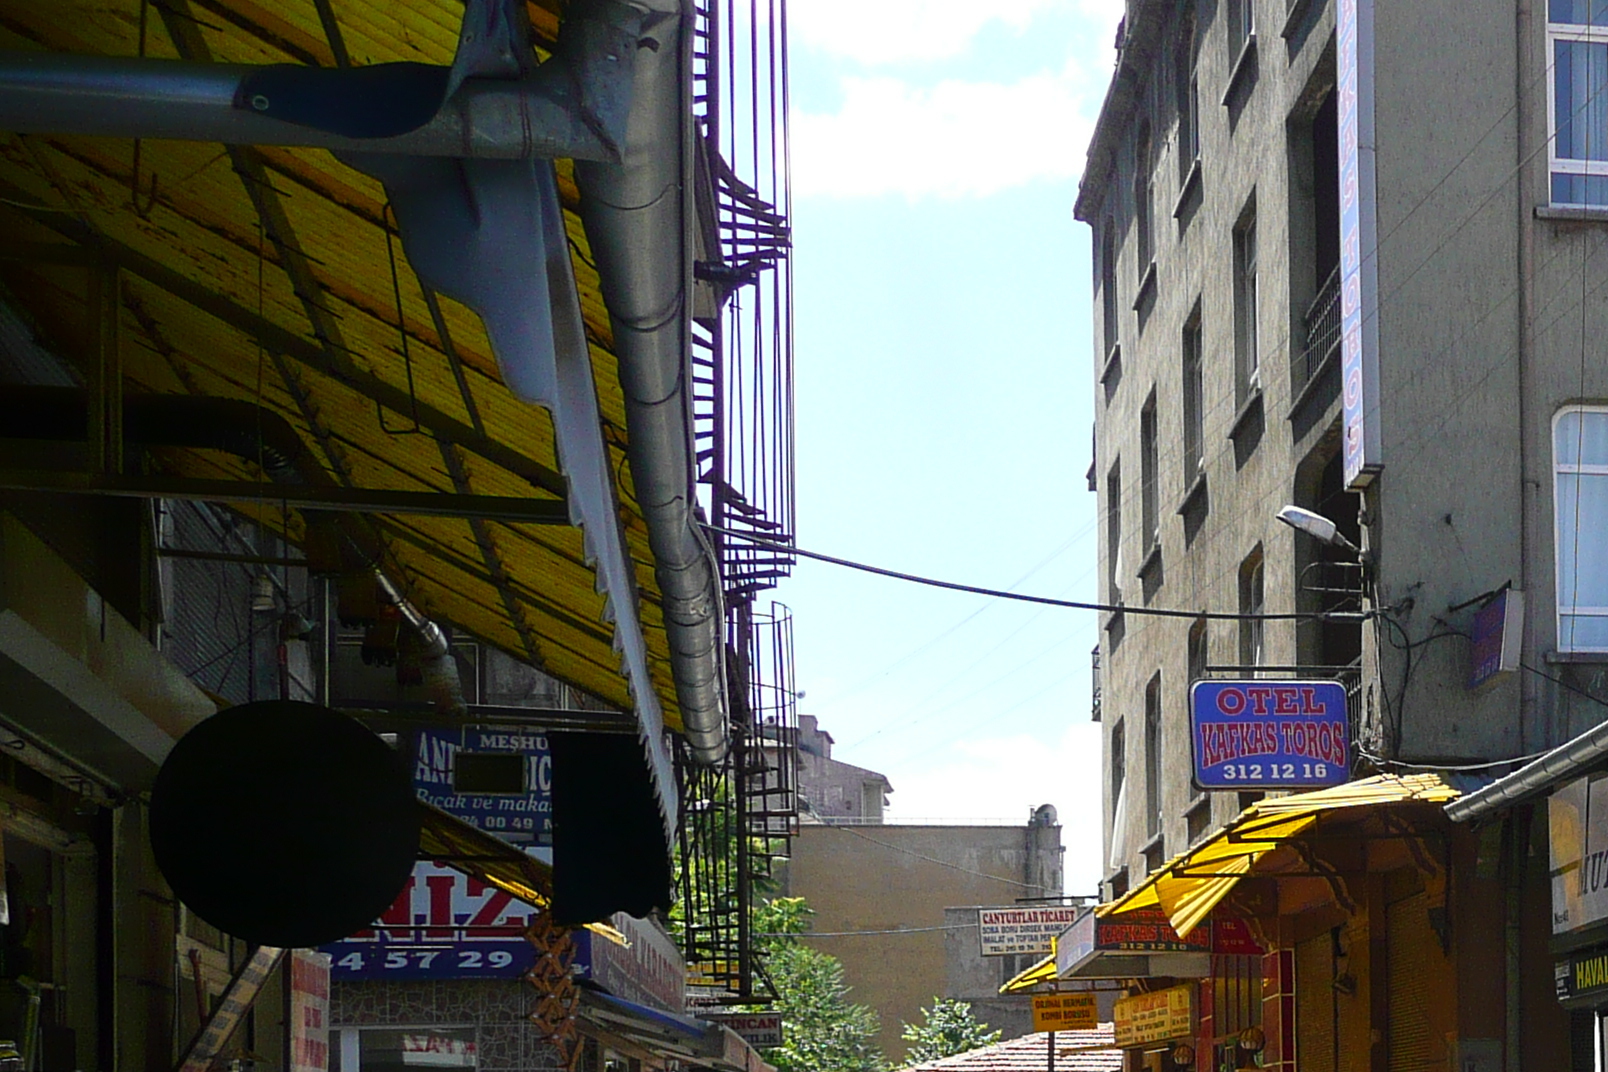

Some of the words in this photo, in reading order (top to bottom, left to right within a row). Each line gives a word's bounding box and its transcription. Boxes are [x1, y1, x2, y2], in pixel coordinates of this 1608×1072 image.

[1216, 687, 1325, 716] OTEL
[479, 734, 550, 752] MEŞHU
[1200, 721, 1278, 769] KAFKAS
[1280, 720, 1345, 768] TOROS
[1223, 763, 1263, 790] 312
[1271, 763, 1295, 789] 12
[1303, 763, 1327, 788] 16
[472, 798, 493, 810] ve
[498, 793, 552, 813] maka
[485, 816, 507, 829] 00
[511, 817, 534, 830] 49
[1100, 923, 1158, 946] KAFKAS
[1119, 942, 1144, 950] 312
[1150, 942, 1166, 950] 12
[383, 951, 441, 970] 57
[457, 950, 514, 970] 29
